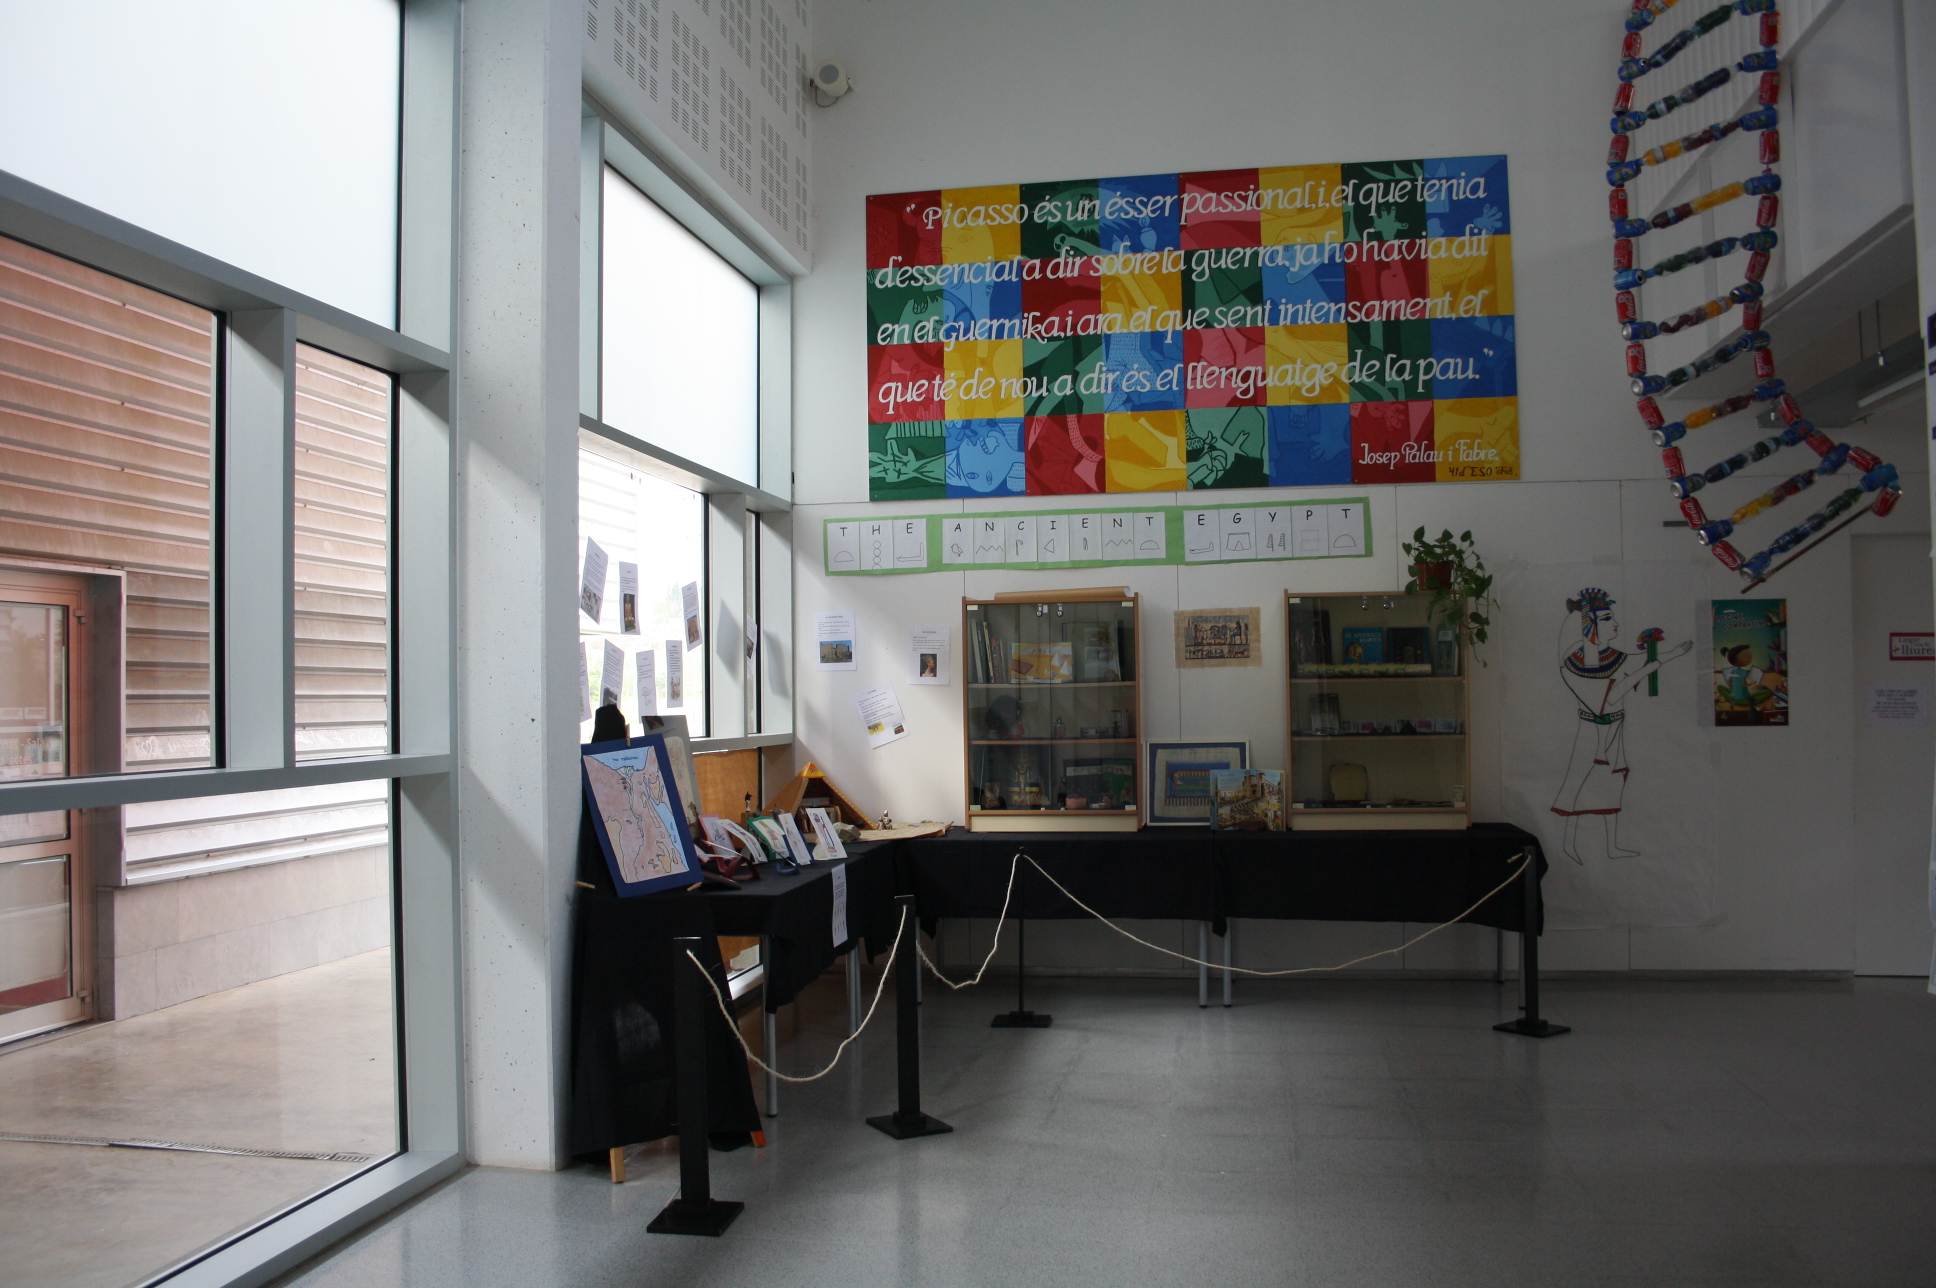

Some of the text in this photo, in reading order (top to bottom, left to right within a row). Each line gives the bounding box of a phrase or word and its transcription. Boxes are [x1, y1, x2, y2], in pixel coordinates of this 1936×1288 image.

[1033, 195, 1063, 223] és
[1066, 198, 1101, 222] un
[1104, 192, 1180, 219] ésser
[1331, 179, 1359, 207] el
[1359, 180, 1412, 216] que
[1414, 172, 1487, 202] tenia
[875, 255, 1021, 289] d'essencial
[1023, 262, 1042, 281] a
[1046, 246, 1089, 279] dir
[1090, 243, 1158, 276] sobre
[1161, 247, 1187, 275] la
[1289, 237, 1321, 272] ja
[1323, 230, 1358, 265] ho
[1362, 229, 1447, 263] havia
[1451, 223, 1489, 258] dit
[876, 322, 911, 346] en
[914, 315, 939, 343] el
[1129, 305, 1158, 332] el
[1155, 306, 1210, 344] que
[1213, 299, 1271, 329] sent
[1458, 289, 1489, 318] el
[877, 378, 929, 415] que
[932, 371, 958, 401] té
[959, 366, 996, 400] de
[999, 374, 1050, 399] nou
[1053, 373, 1076, 397] a
[1079, 360, 1122, 396] dir
[1121, 363, 1152, 393] és
[1155, 362, 1184, 391] el
[1186, 361, 1339, 399] llenguatge
[1341, 349, 1382, 384] de
[1384, 353, 1415, 383] la
[1358, 443, 1401, 470] Josep
[1401, 440, 1444, 464] Palau
[1447, 446, 1453, 462] i
[839, 508, 1351, 537] THE ANCIENT EGYPT
